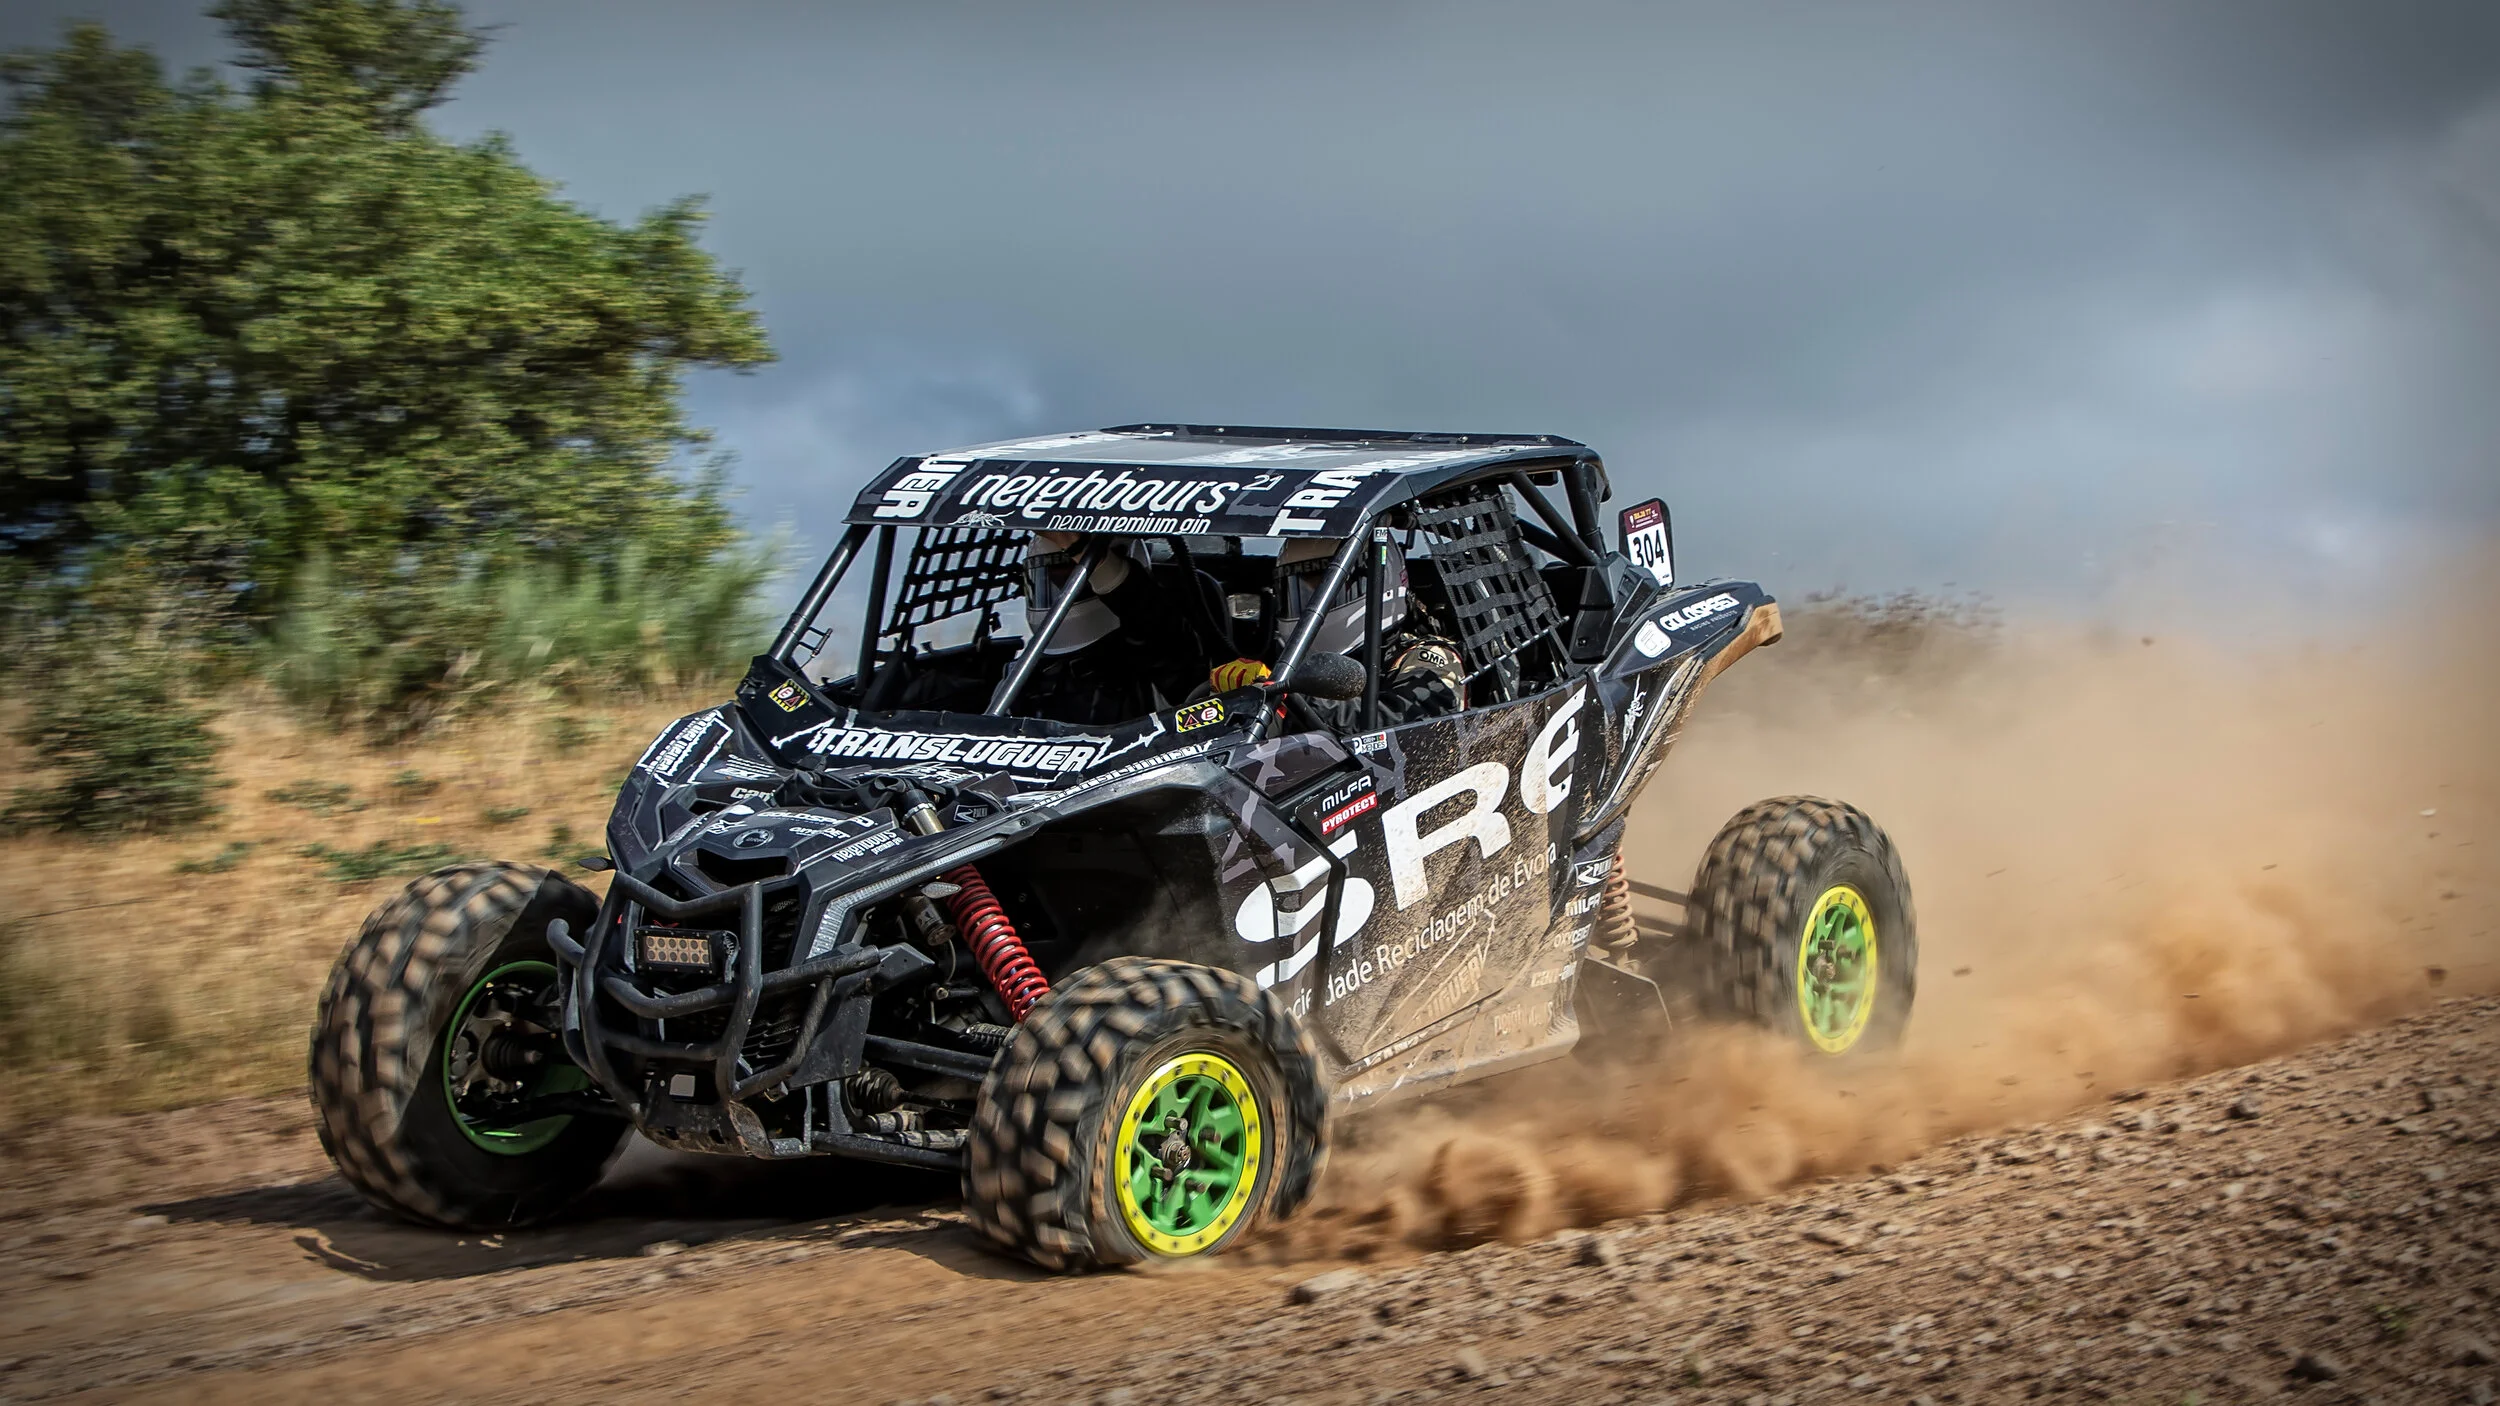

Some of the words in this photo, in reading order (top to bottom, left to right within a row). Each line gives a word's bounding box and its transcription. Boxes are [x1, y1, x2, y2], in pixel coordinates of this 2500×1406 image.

[958, 467, 1240, 519] neighbours
[1091, 512, 1181, 533] premium
[1179, 513, 1211, 535] gin
[1632, 529, 1665, 568] 304
[1205, 709, 1214, 719] E
[812, 728, 1100, 770] TRANSLUGUER
[1323, 775, 1372, 811] MILFA
[1322, 795, 1376, 833] PYROTECT
[1375, 892, 1485, 975] Reciclagem
[1488, 873, 1511, 905] de
[1513, 842, 1557, 889] Évora
